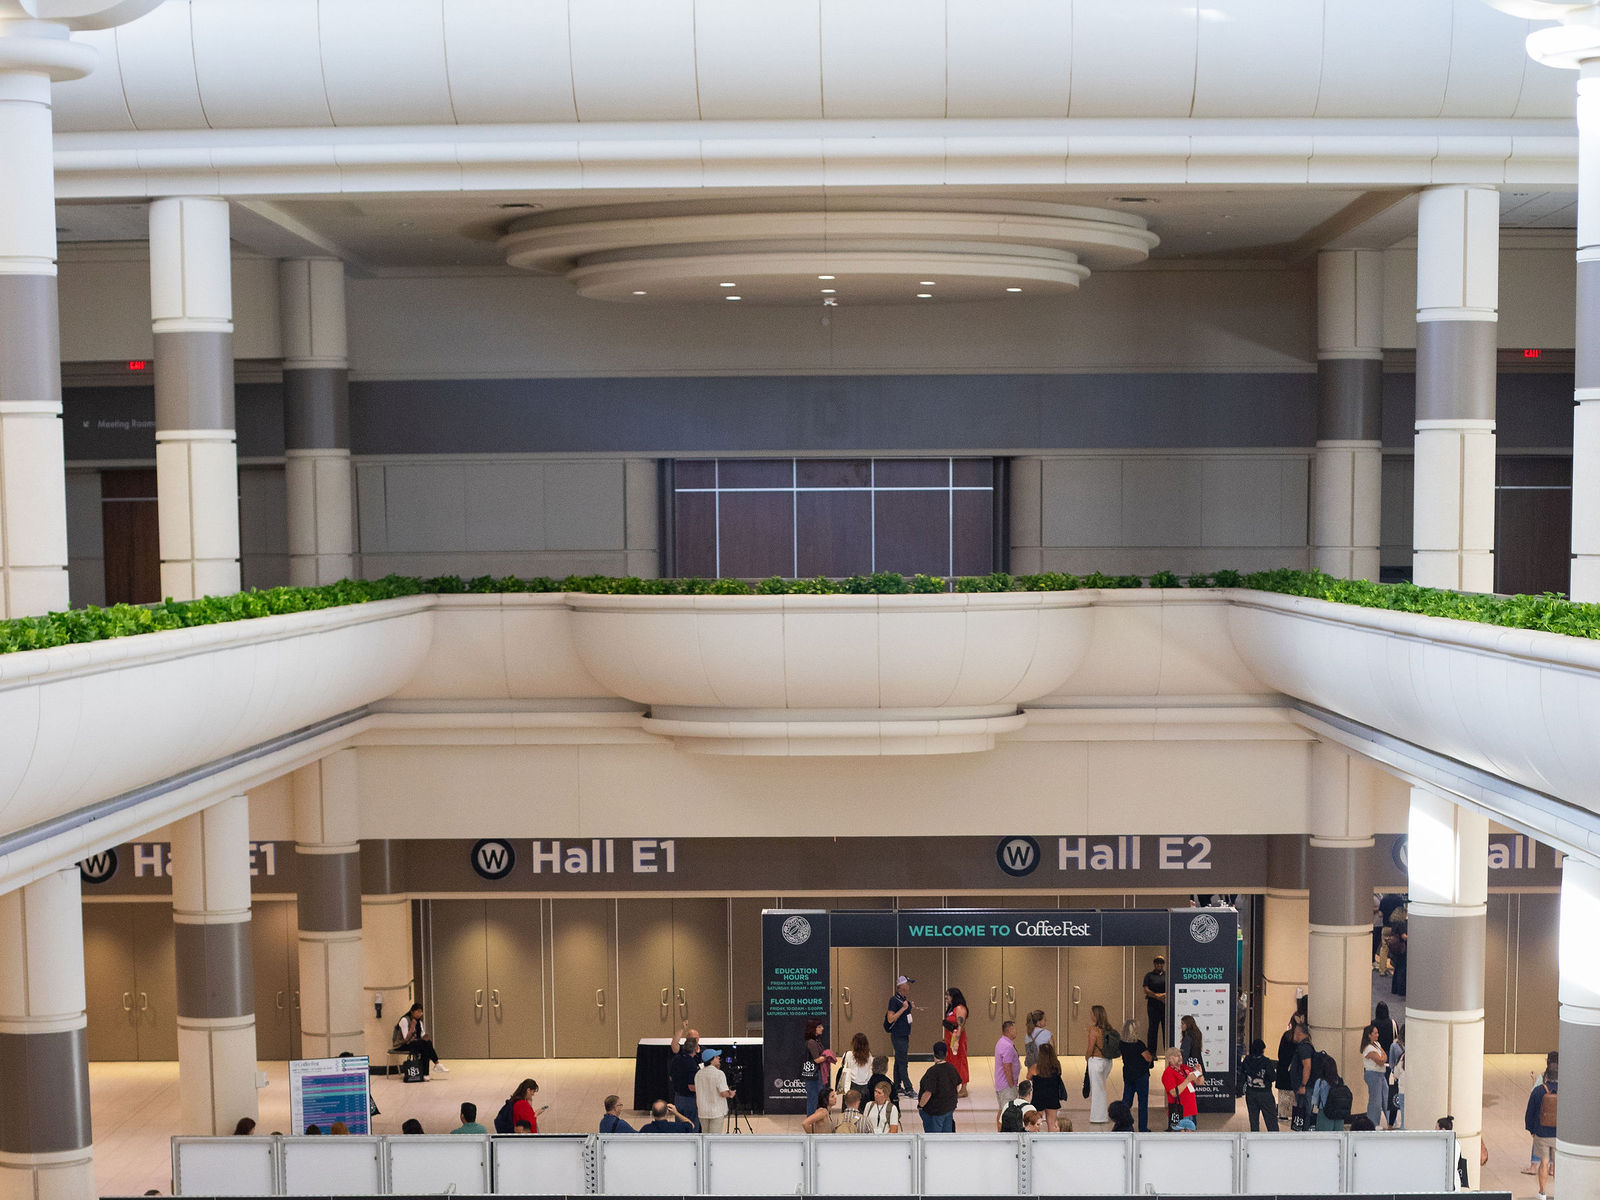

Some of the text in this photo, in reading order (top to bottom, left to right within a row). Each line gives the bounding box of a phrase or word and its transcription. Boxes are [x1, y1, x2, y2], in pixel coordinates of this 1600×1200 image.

[532, 839, 615, 874] Hall
[632, 840, 675, 873] E1
[1058, 836, 1141, 870] Hall
[1159, 836, 1212, 870] E2
[1488, 834, 1536, 869] all
[909, 925, 985, 937] WELCOME
[990, 925, 1010, 937] TO
